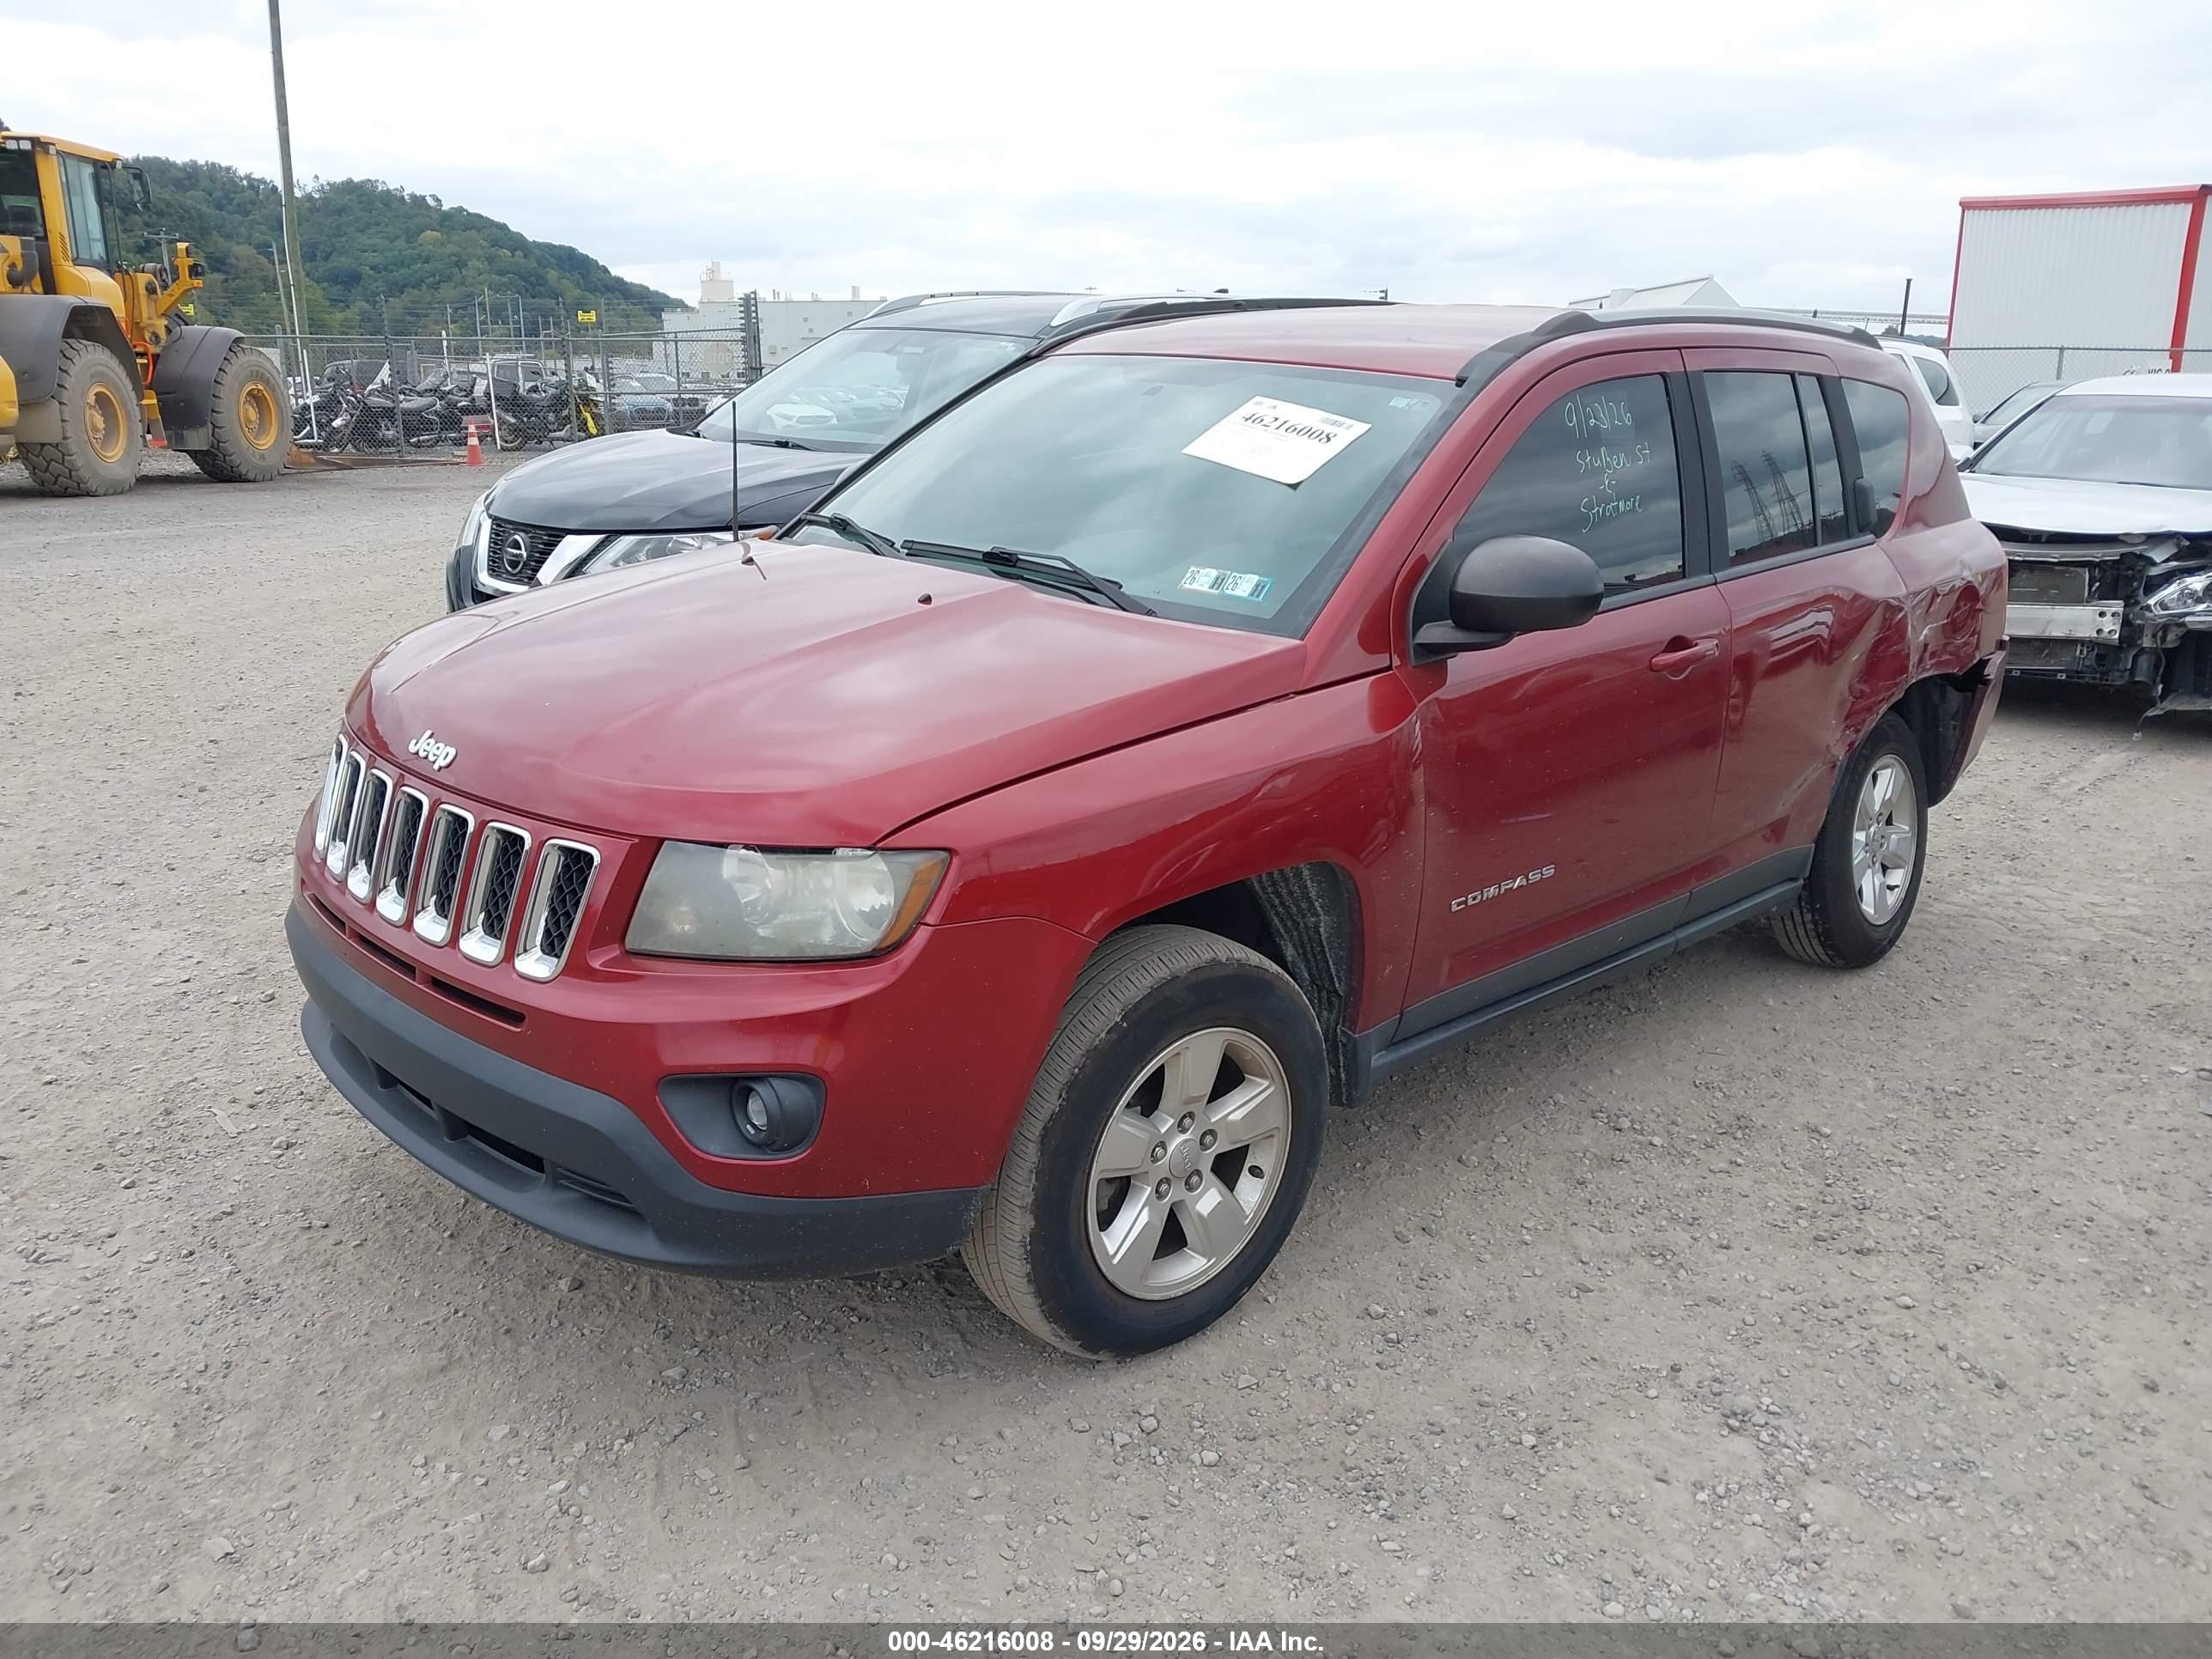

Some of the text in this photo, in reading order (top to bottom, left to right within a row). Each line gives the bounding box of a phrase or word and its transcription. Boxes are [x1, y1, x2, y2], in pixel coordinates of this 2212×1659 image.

[1241, 411, 1339, 444] 46216008
[1565, 393, 1632, 440] 9/23/26
[1635, 441, 1650, 464] St
[1183, 569, 1200, 586] 26
[1225, 574, 1243, 592] 26
[408, 729, 458, 771] Jeep
[1450, 864, 1557, 913] COMPASS
